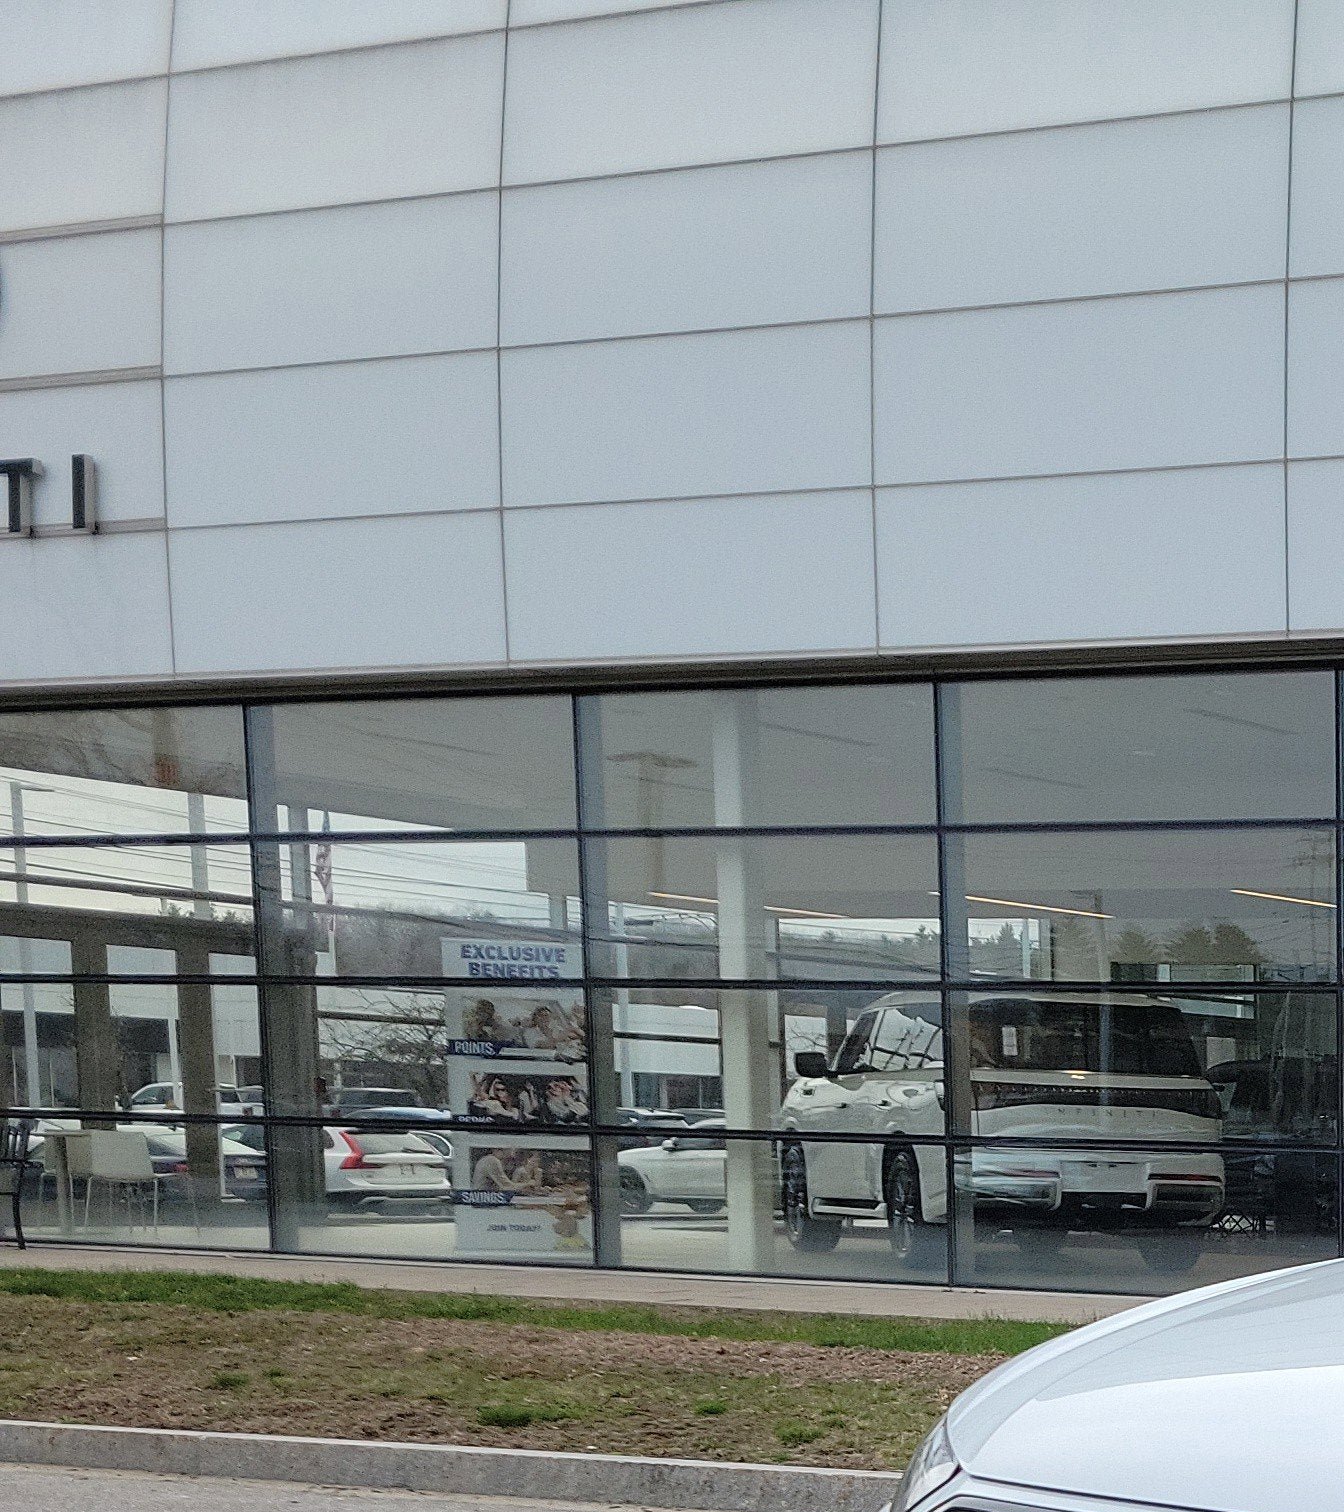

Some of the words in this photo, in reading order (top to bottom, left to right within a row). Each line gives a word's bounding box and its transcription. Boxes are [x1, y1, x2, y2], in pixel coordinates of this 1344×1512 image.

[460, 944, 566, 963] EXCLUSIVE
[468, 962, 559, 980] BENEFITS
[454, 1041, 496, 1056] POINTS
[461, 1191, 508, 1204] SAVINGS
